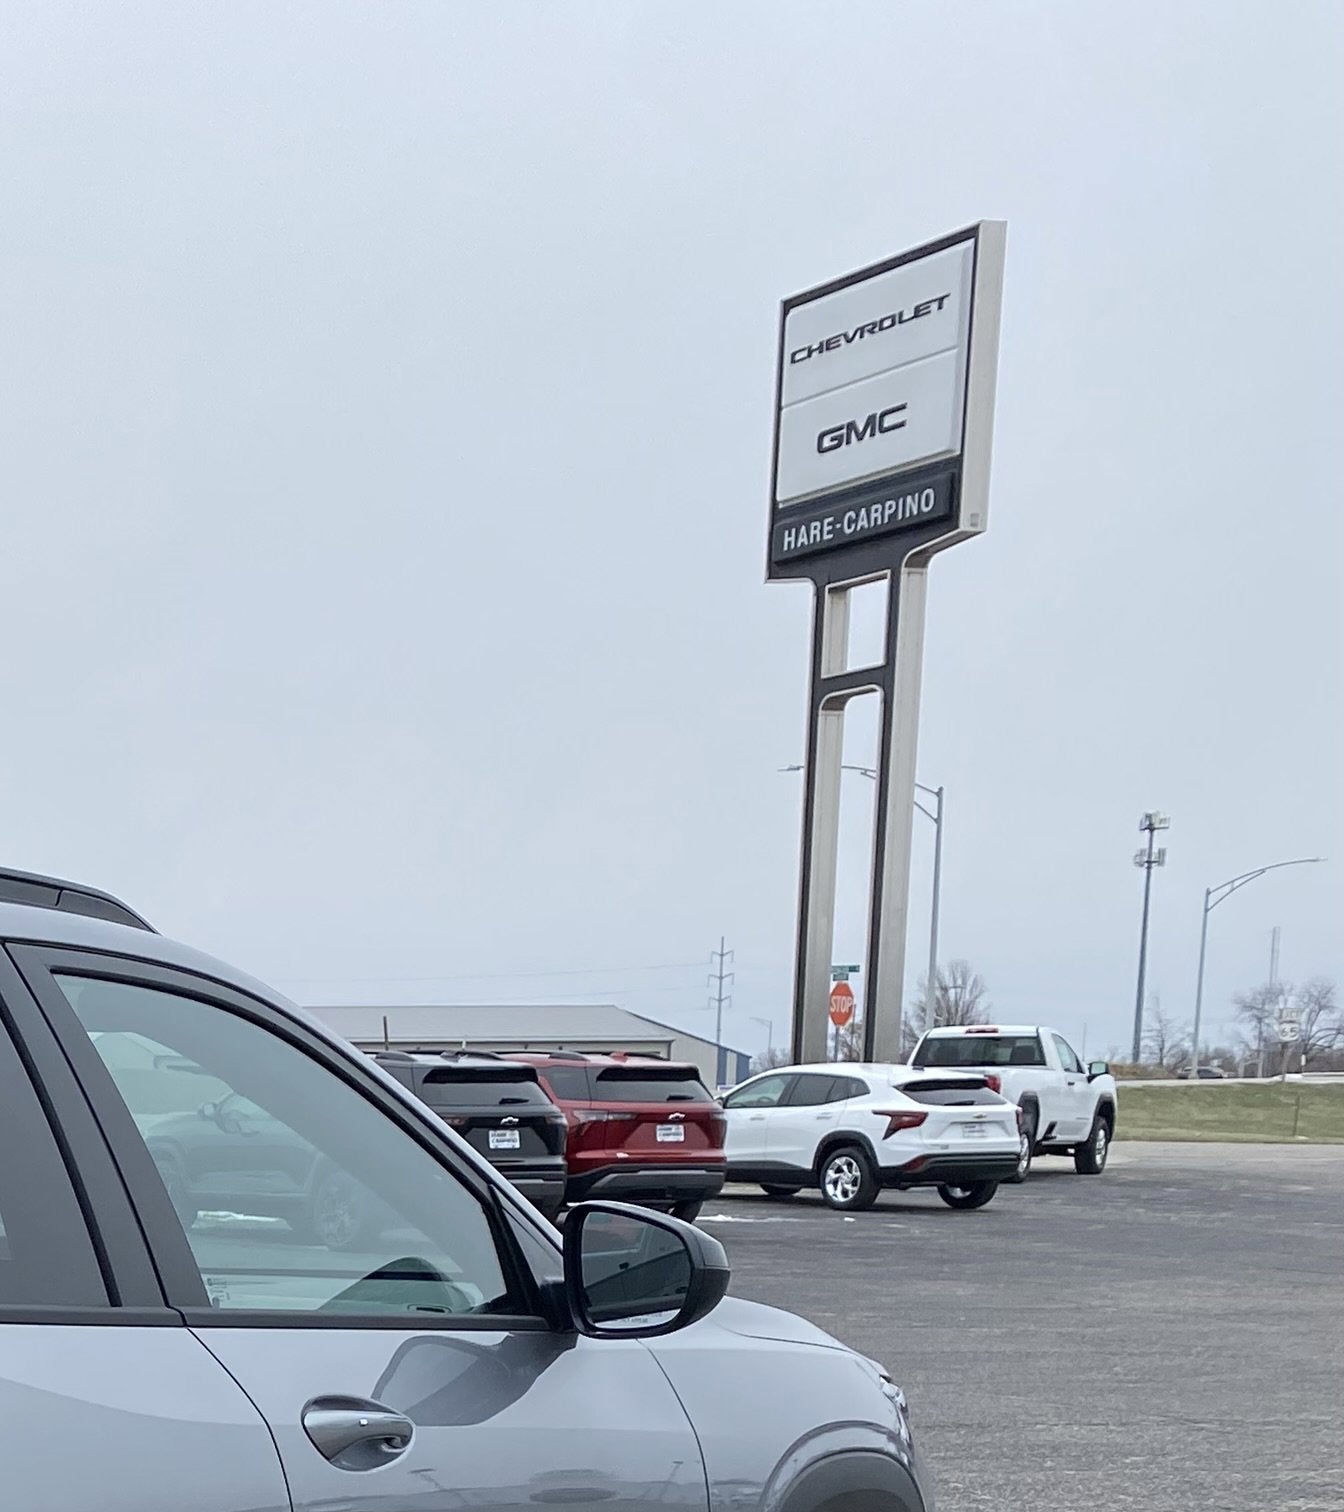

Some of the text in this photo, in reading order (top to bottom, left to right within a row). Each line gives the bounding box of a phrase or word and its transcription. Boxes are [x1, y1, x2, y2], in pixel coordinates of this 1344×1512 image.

[790, 293, 951, 364] CHEVROLET
[817, 402, 908, 454] GMC
[783, 487, 936, 552] HARE-CARPINO
[830, 995, 853, 1014] STOP
